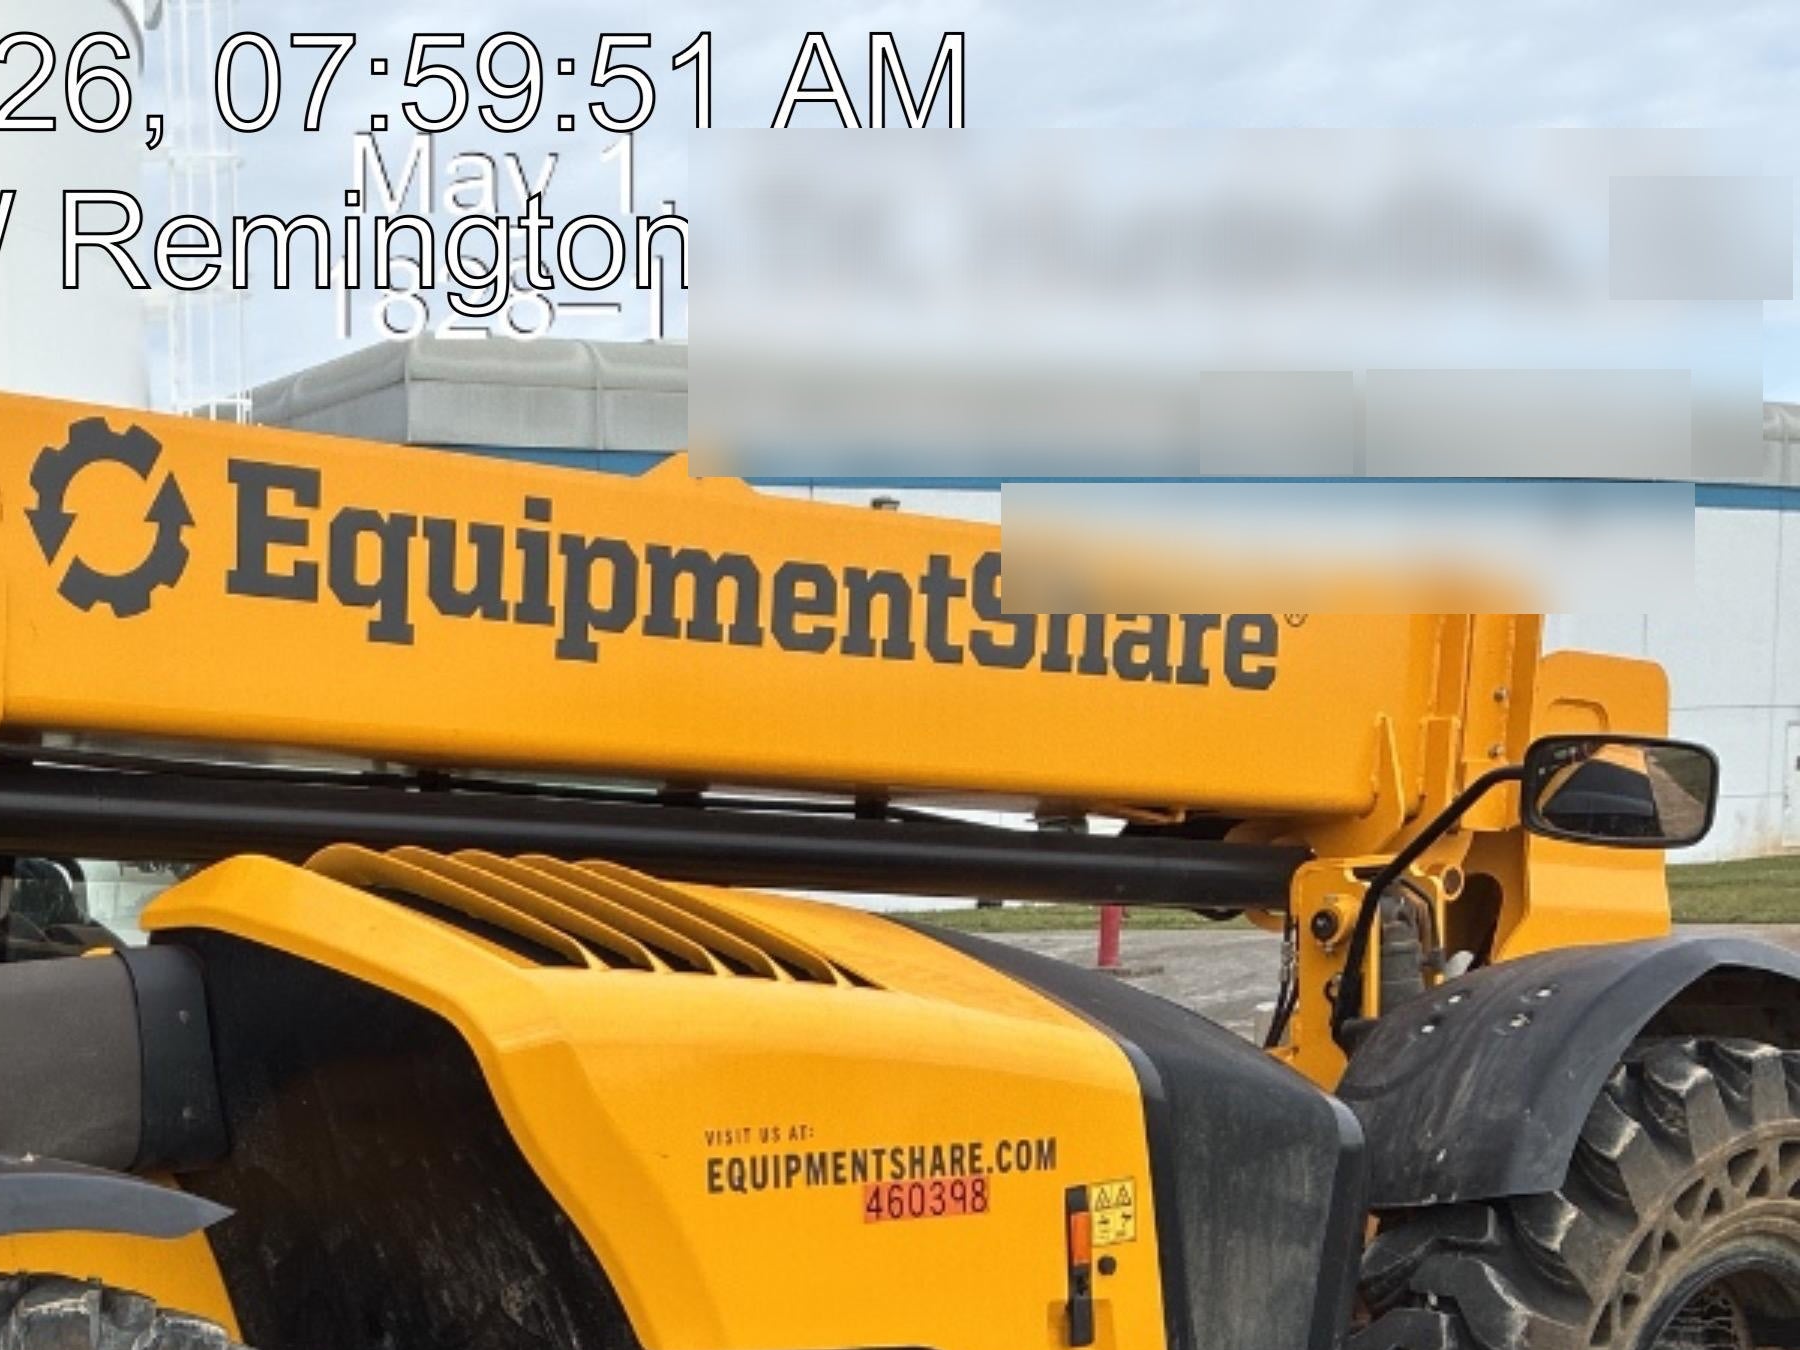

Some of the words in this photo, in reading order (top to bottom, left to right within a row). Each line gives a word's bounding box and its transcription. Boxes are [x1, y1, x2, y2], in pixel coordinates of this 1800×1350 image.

[704, 1127, 752, 1147] VISIT
[758, 1126, 781, 1144] US
[788, 1124, 815, 1141] AT:
[706, 1137, 1057, 1194] EQUIPMENTSHARE.COM
[865, 1179, 988, 1219] 460398
